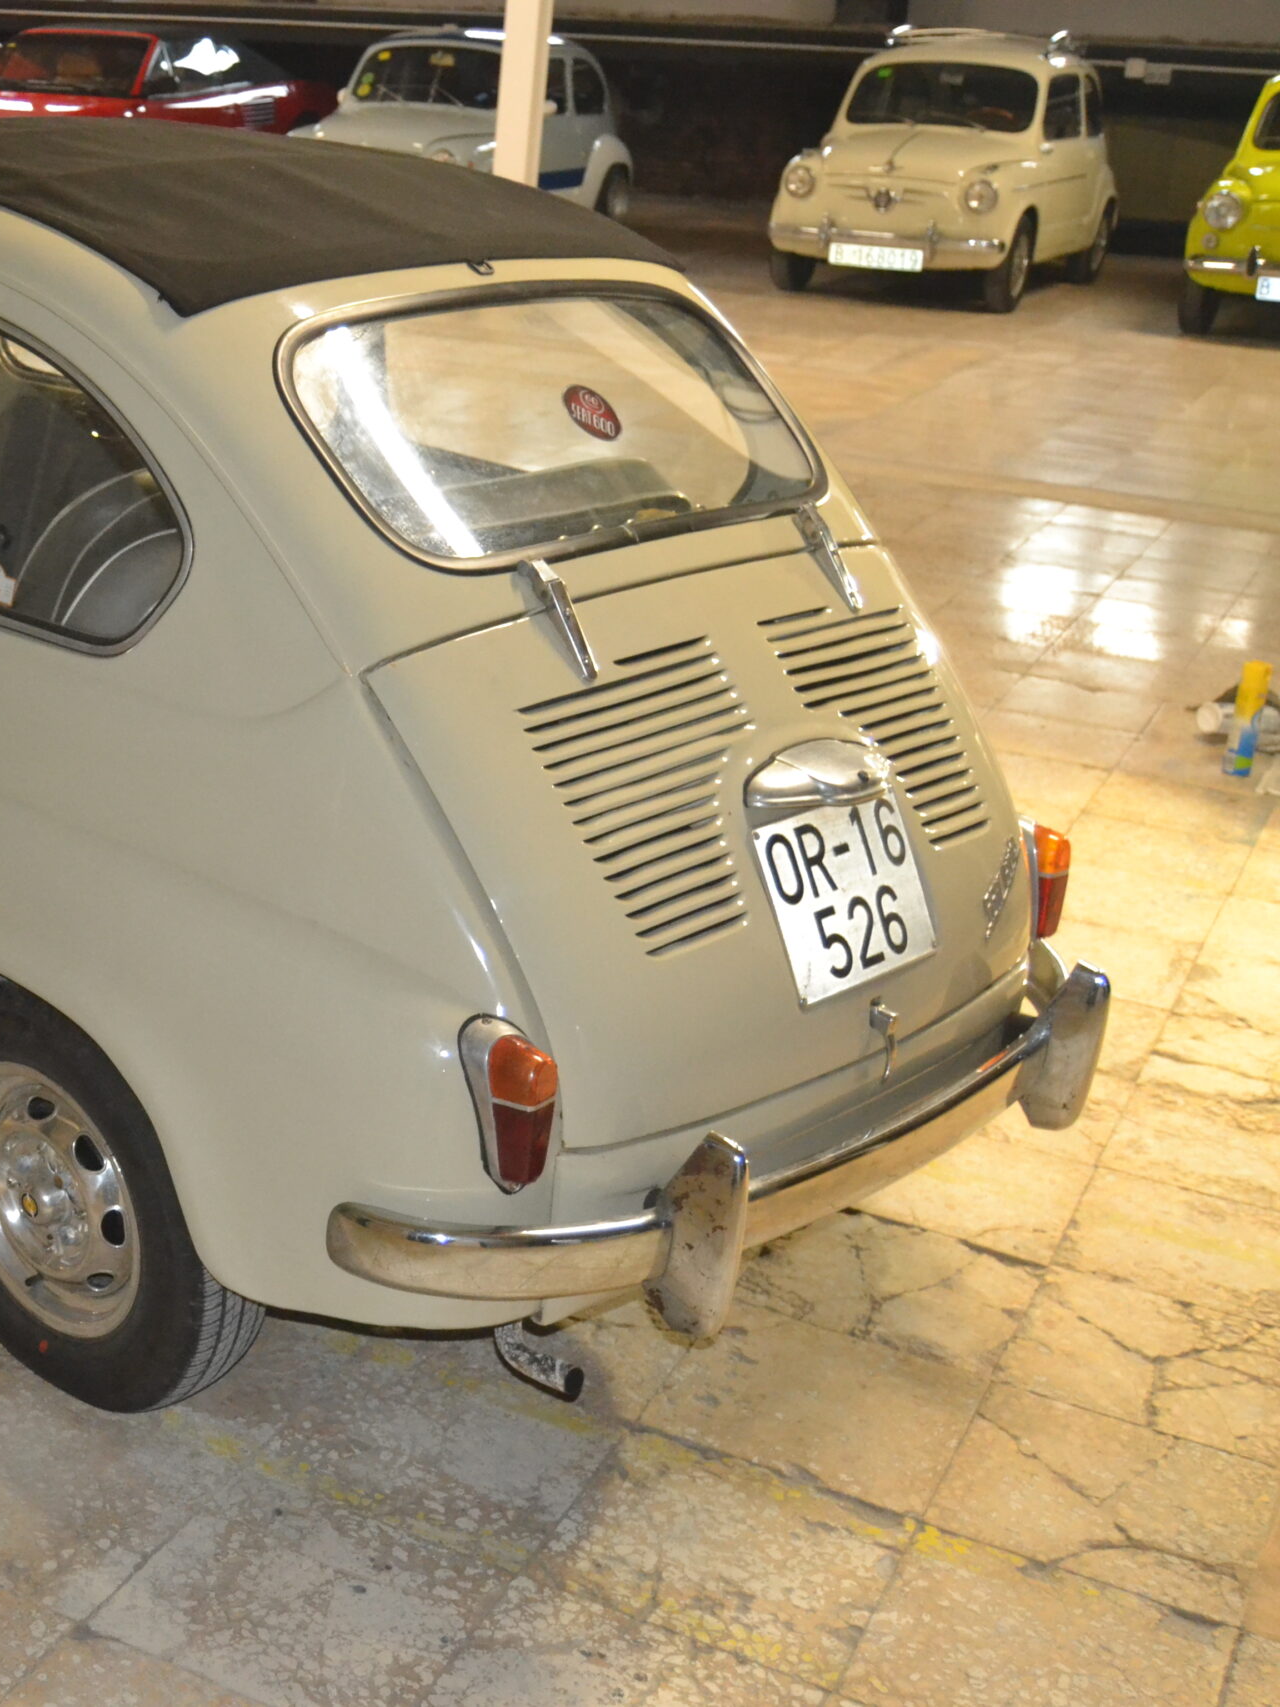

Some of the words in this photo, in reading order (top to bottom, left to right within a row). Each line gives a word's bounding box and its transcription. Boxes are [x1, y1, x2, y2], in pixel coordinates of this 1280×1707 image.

[571, 402, 591, 425] SEAT
[592, 414, 615, 437] 600
[765, 798, 906, 905] OR-16
[814, 885, 908, 979] 526
